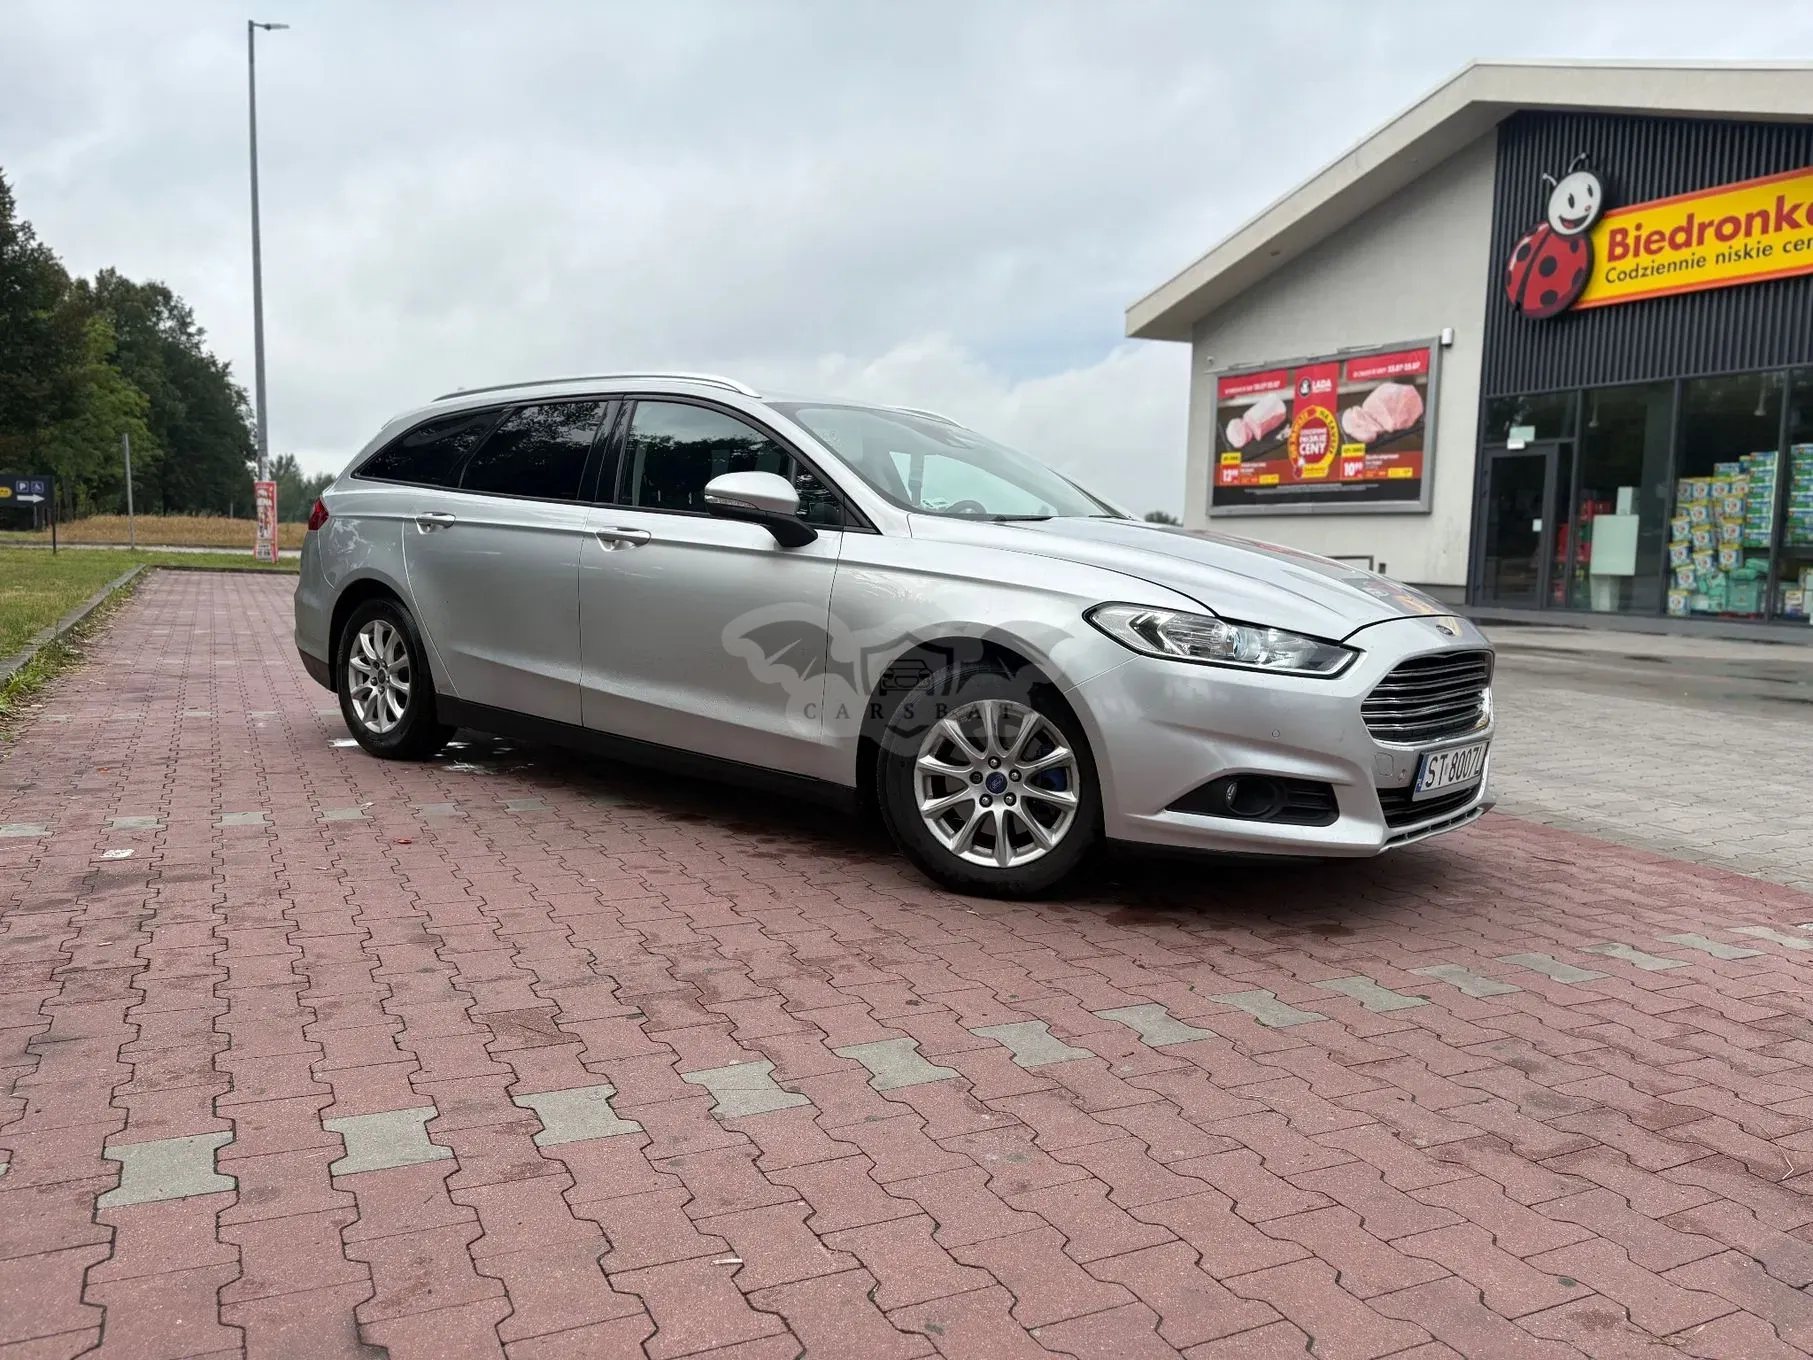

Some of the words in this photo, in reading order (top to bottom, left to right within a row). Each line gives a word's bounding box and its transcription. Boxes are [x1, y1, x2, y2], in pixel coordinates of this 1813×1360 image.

[1607, 195, 1813, 263] Biedronk
[1605, 252, 1706, 284] Codziennie
[1715, 240, 1773, 265] niskie
[1425, 753, 1448, 788] ST
